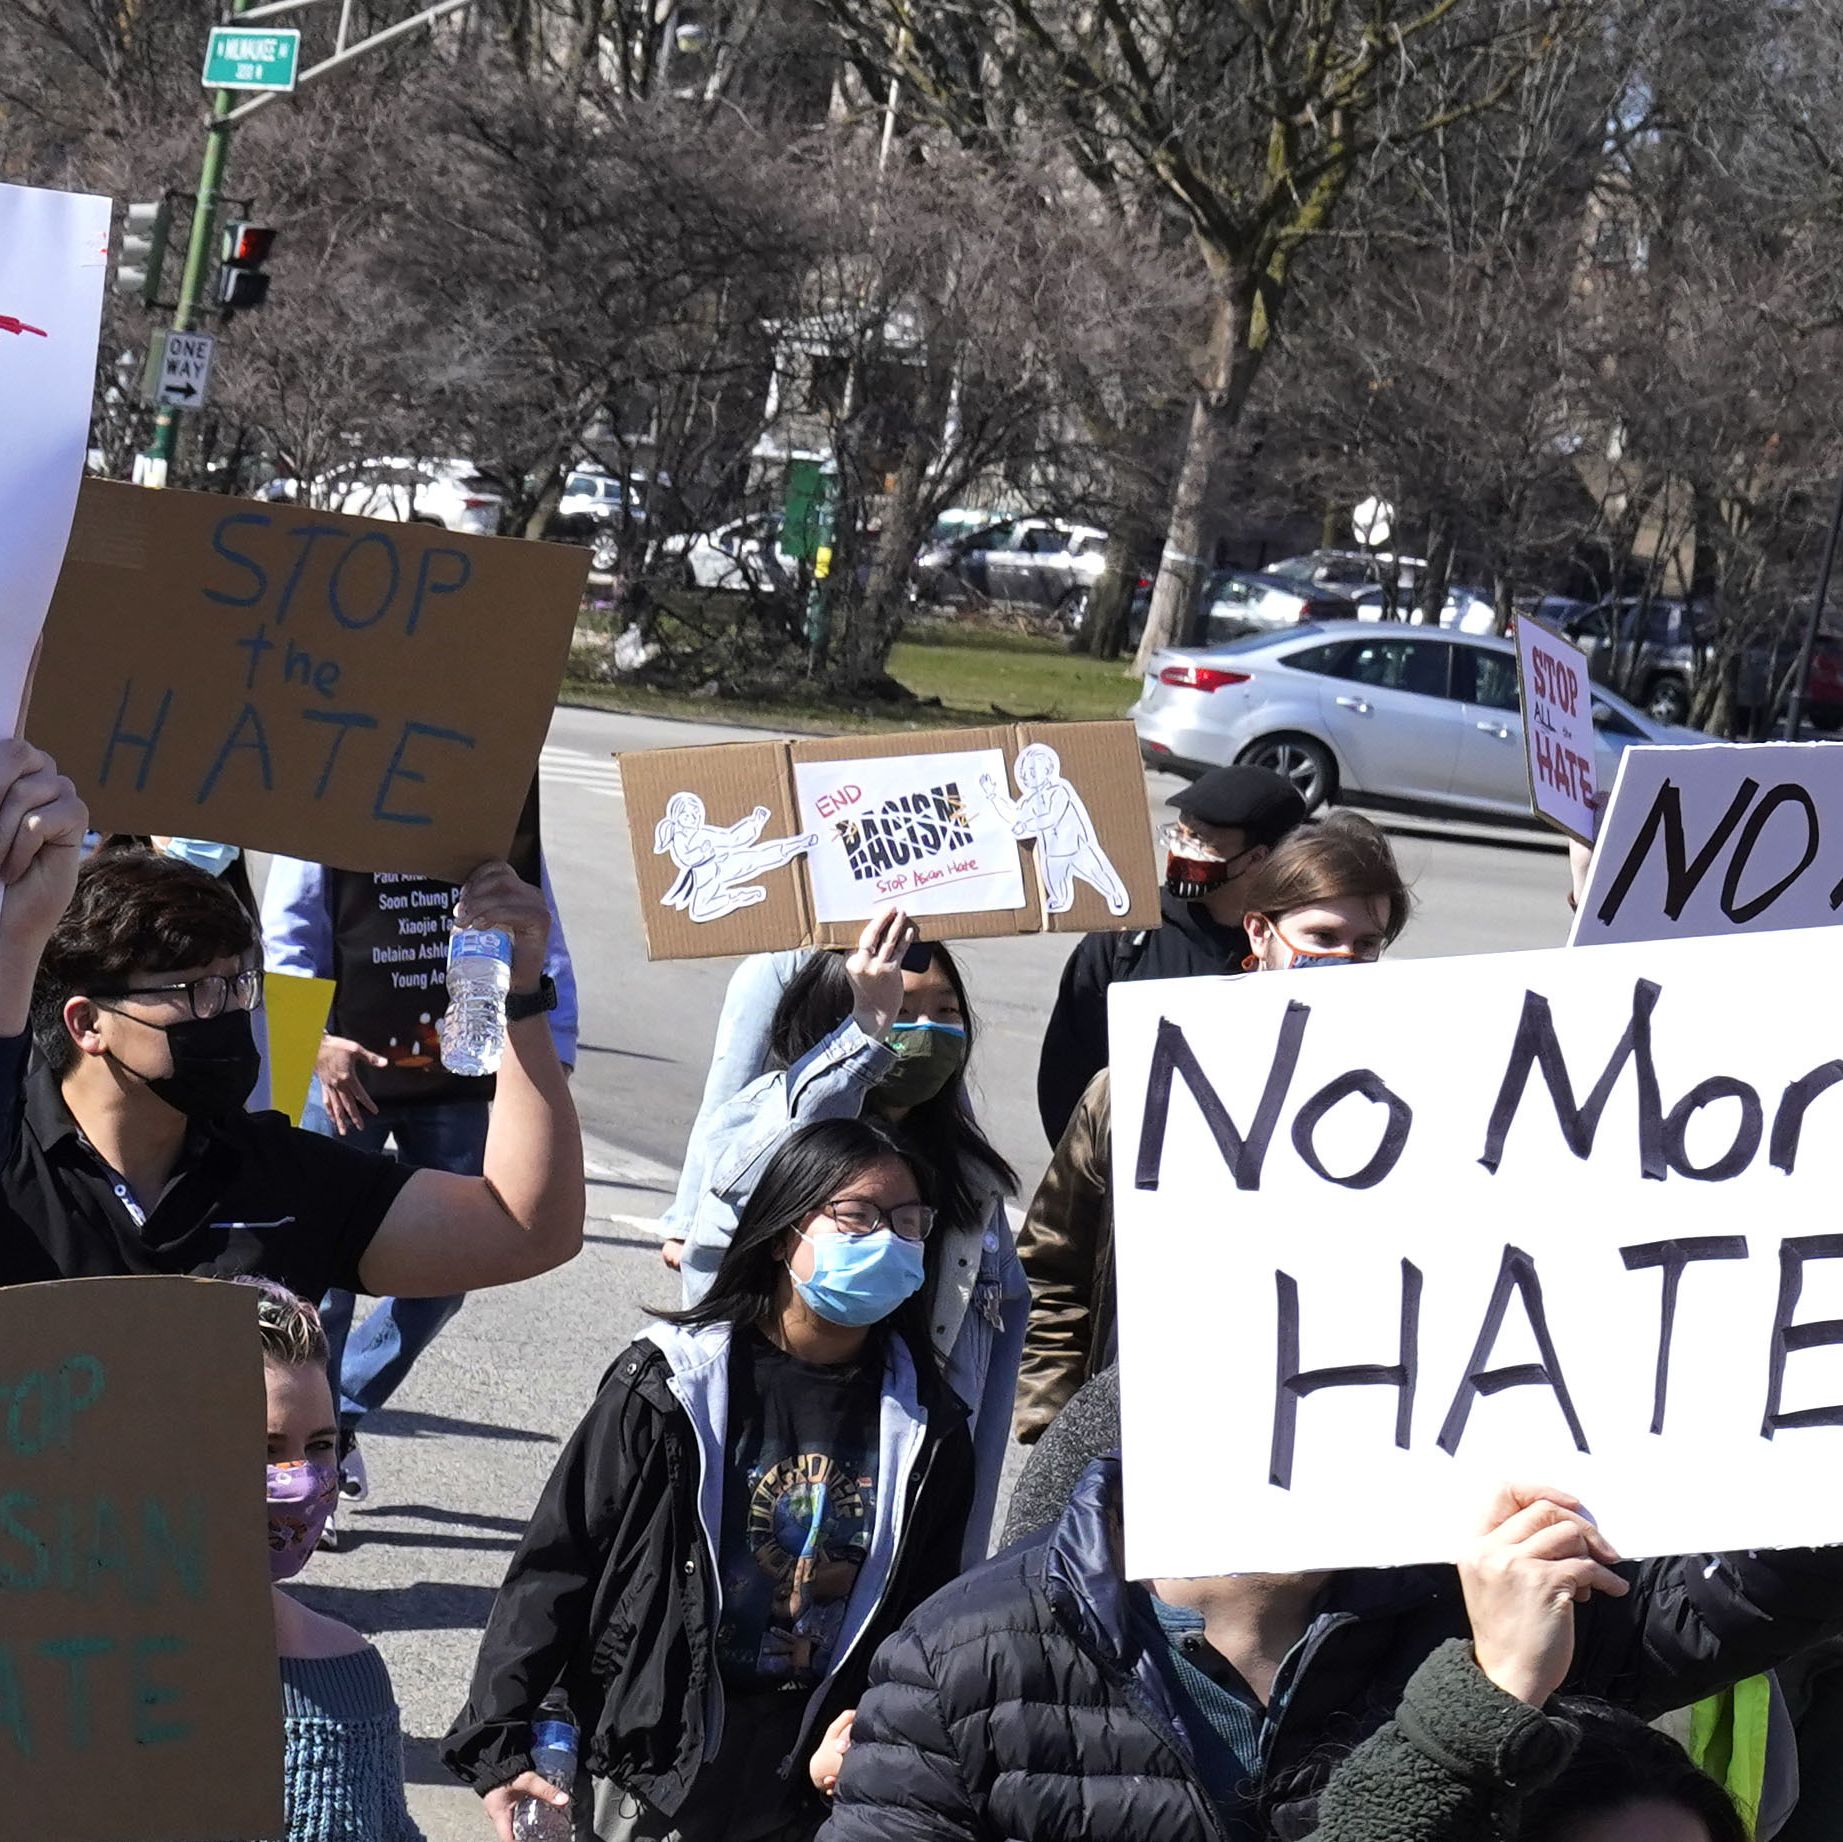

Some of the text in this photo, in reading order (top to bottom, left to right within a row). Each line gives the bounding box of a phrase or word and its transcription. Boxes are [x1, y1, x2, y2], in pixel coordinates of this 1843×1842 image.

[167, 358, 204, 378] WAY
[170, 338, 208, 358] ONE
[202, 511, 471, 636] STOP
[237, 625, 341, 697] the
[1533, 646, 1578, 718] STOP
[1534, 701, 1557, 734] ALL
[98, 678, 475, 825] HATE
[1535, 730, 1595, 810] HATE
[815, 785, 862, 818] END
[836, 783, 974, 880] RACISM
[1597, 777, 1820, 927] NO
[913, 870, 944, 888] Asian
[948, 859, 979, 876] Hate
[379, 893, 408, 911] Soon
[410, 890, 449, 909] Chung
[398, 917, 454, 937] Xiaojie Ta
[372, 946, 415, 964] Delaina
[418, 943, 449, 960] Ashle
[391, 972, 428, 990] Young
[1134, 979, 1843, 1192] No Mor
[1269, 1234, 1843, 1491] HATE
